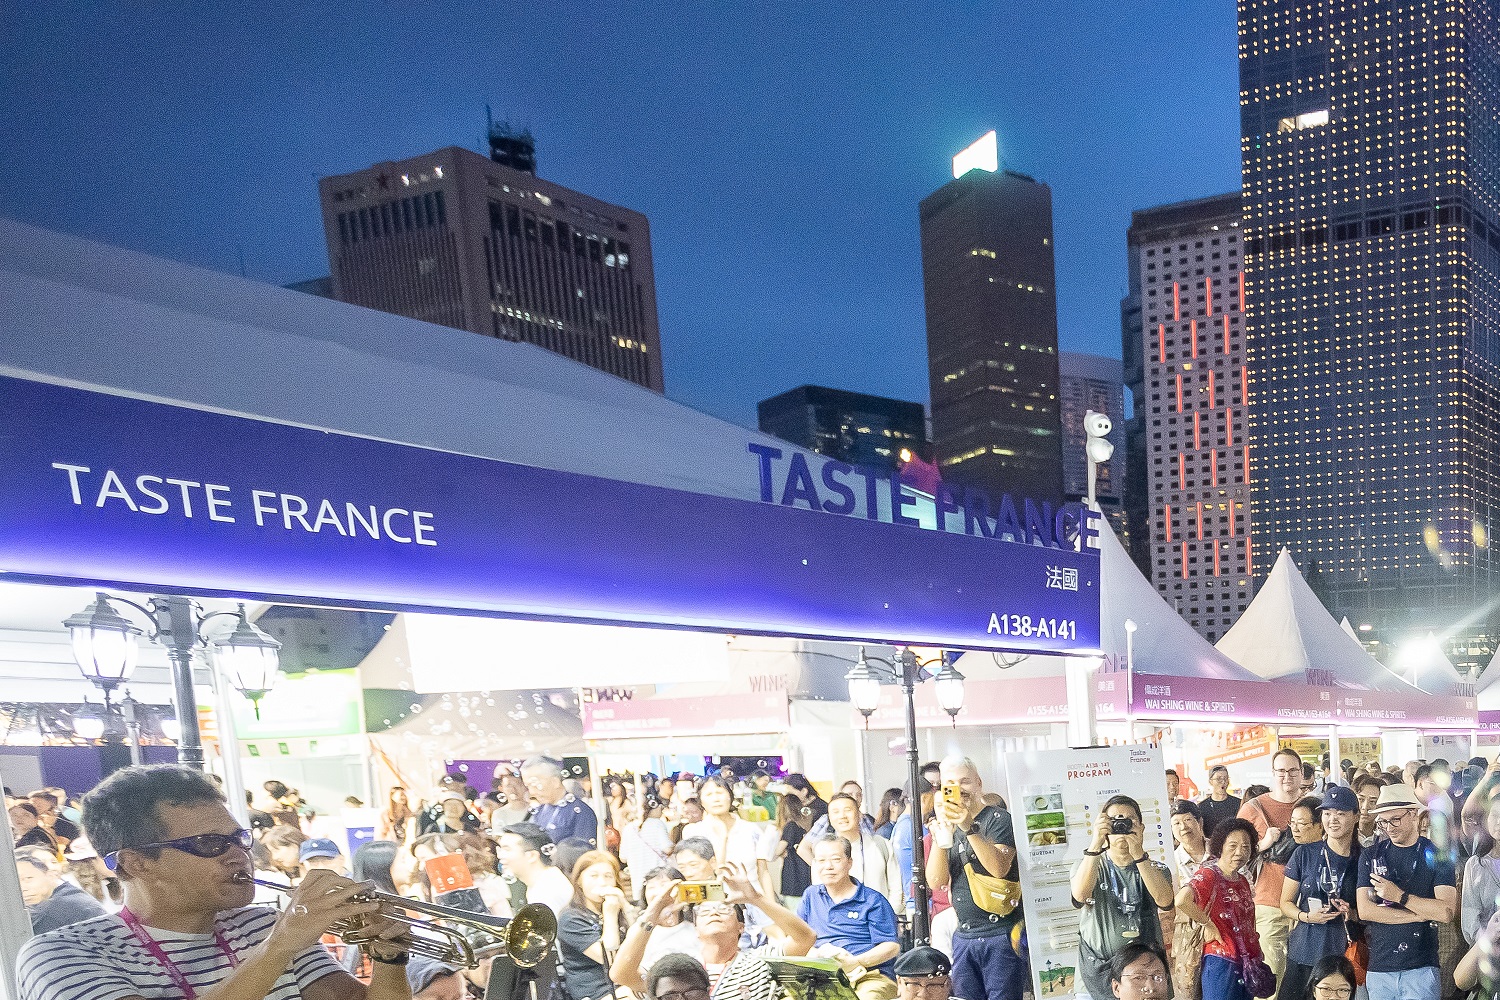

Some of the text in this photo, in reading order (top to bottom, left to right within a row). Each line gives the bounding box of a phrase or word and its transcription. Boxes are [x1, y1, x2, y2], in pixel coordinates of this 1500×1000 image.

[52, 462, 438, 546] TASTE FRANCE
[748, 443, 1101, 555] TASTE FRANCE
[1045, 565, 1078, 591] 法國
[987, 612, 1076, 640] A138-A141
[1145, 699, 1160, 709] WAI
[1160, 700, 1184, 711] SHING
[1185, 701, 1203, 711] WINE
[1068, 769, 1112, 780] PROGRAM
